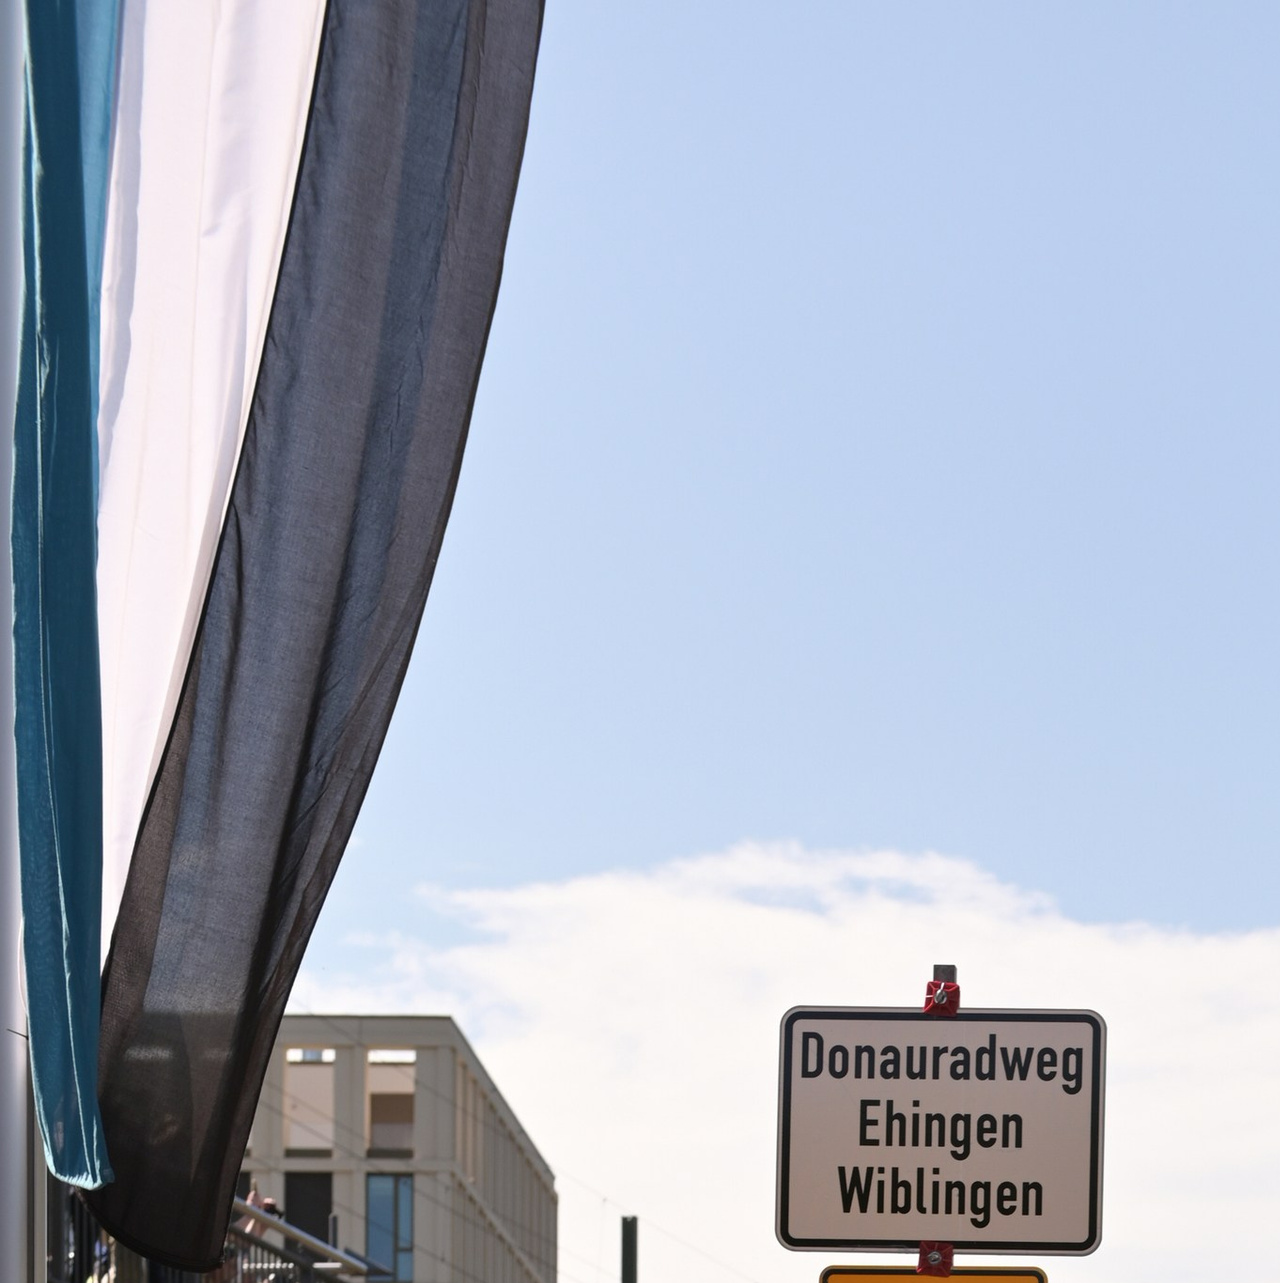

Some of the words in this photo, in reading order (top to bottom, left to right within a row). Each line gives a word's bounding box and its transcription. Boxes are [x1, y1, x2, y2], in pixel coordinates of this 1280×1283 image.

[800, 1031, 1084, 1096] Donauradweg
[858, 1098, 1023, 1162] Ehingen
[837, 1166, 1044, 1229] Wiblingen
